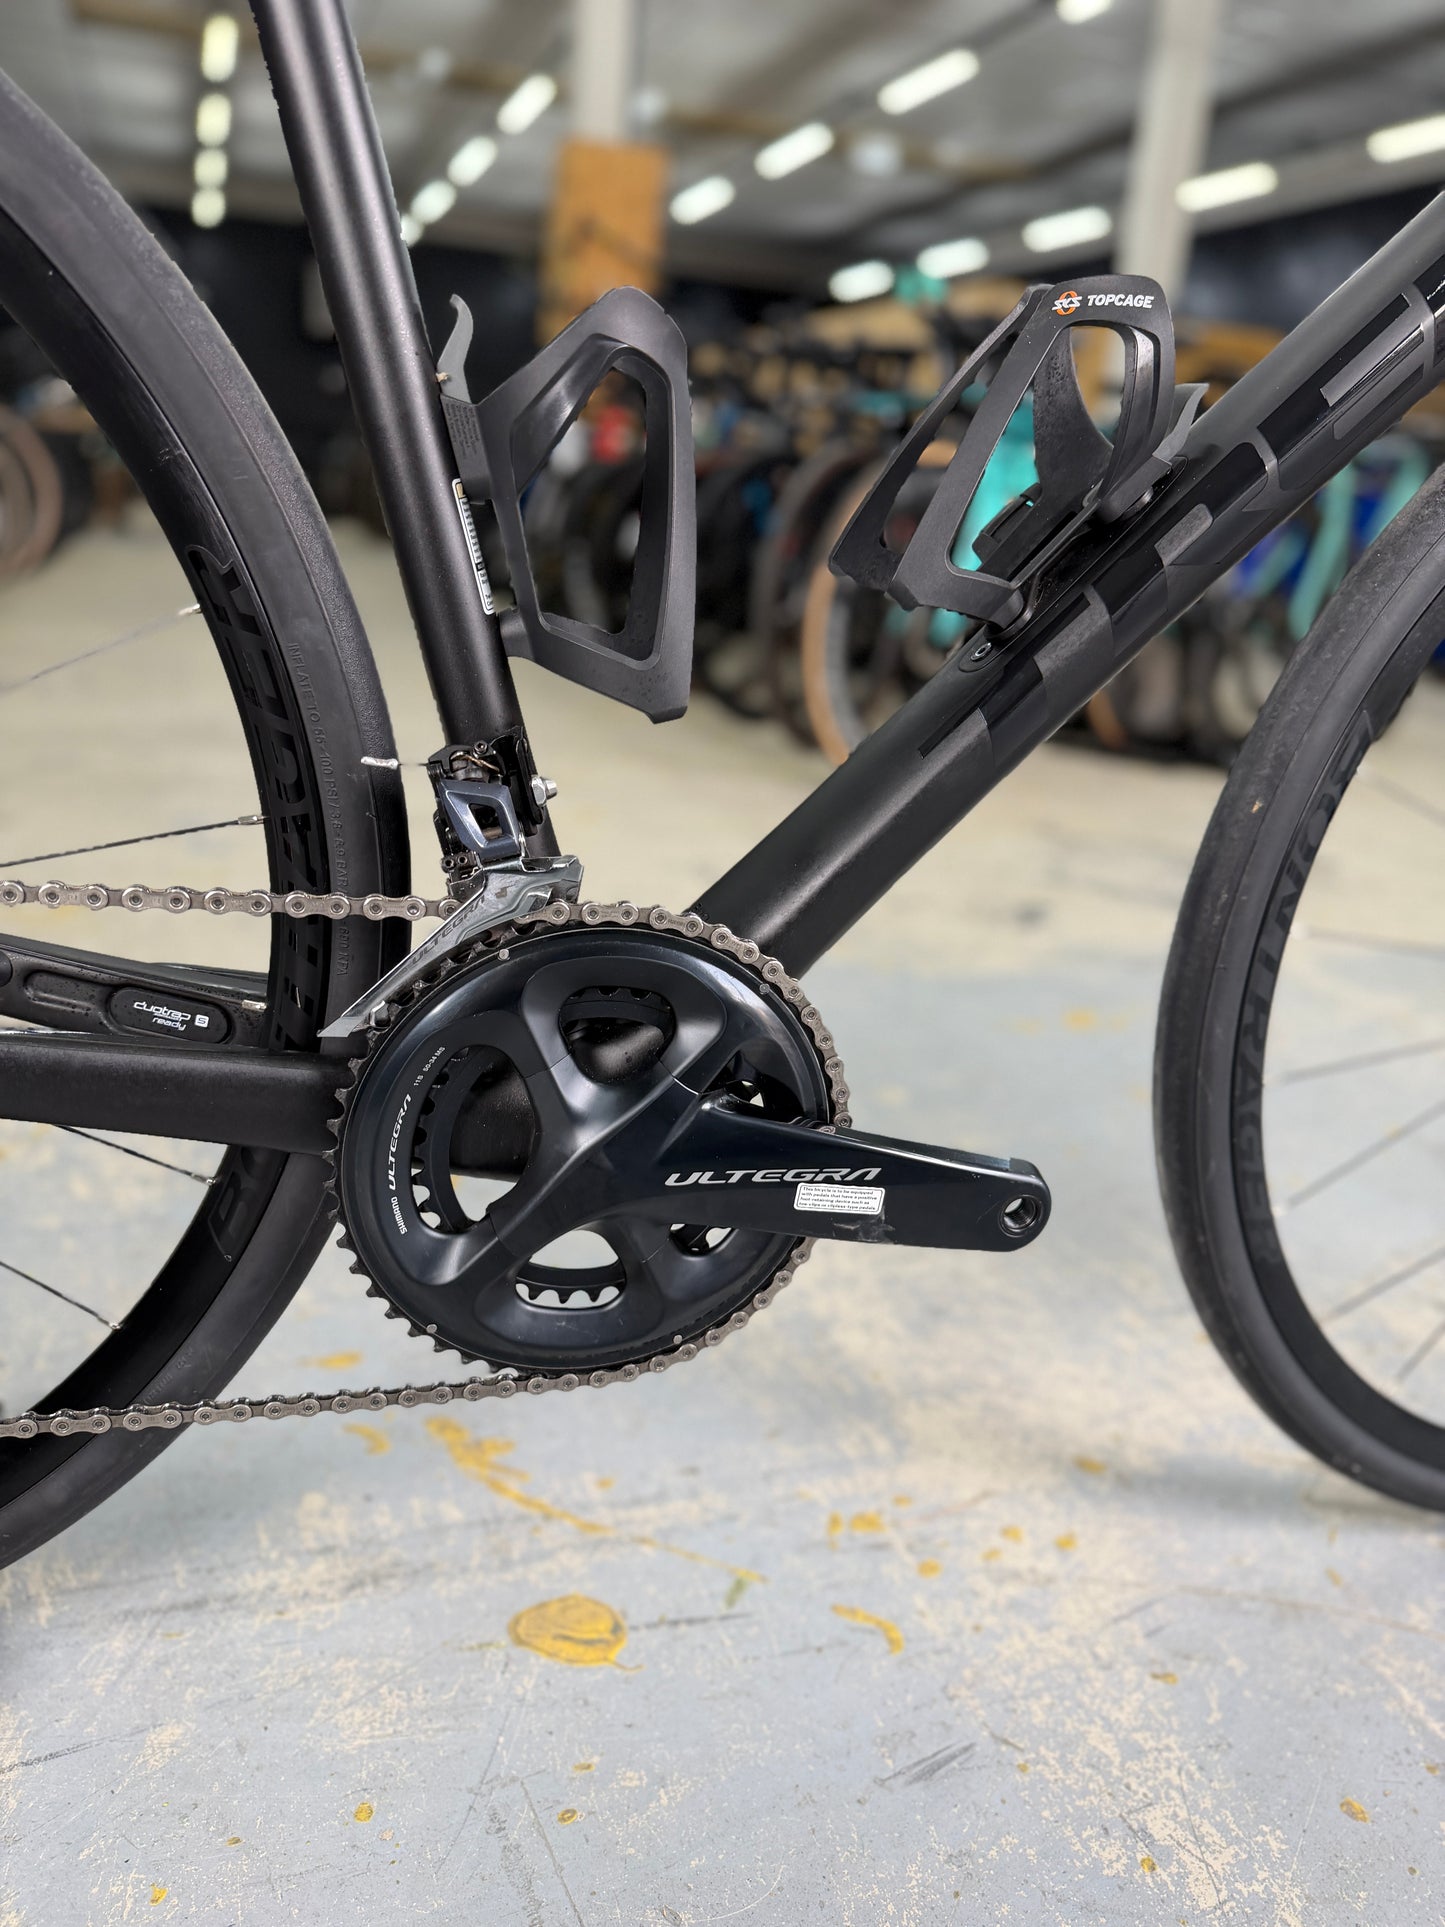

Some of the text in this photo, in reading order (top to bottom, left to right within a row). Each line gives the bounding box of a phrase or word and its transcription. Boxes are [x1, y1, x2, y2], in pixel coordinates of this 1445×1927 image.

[1087, 294, 1155, 309] TOPCAGE
[289, 643, 313, 698] INFLATE
[308, 703, 320, 722] TO
[336, 860, 348, 886] BAR
[152, 1018, 186, 1031] ready
[388, 1093, 411, 1190] ULTEGRA
[664, 1167, 882, 1187] ULTEGRA
[391, 1197, 408, 1235] SHIMANO
